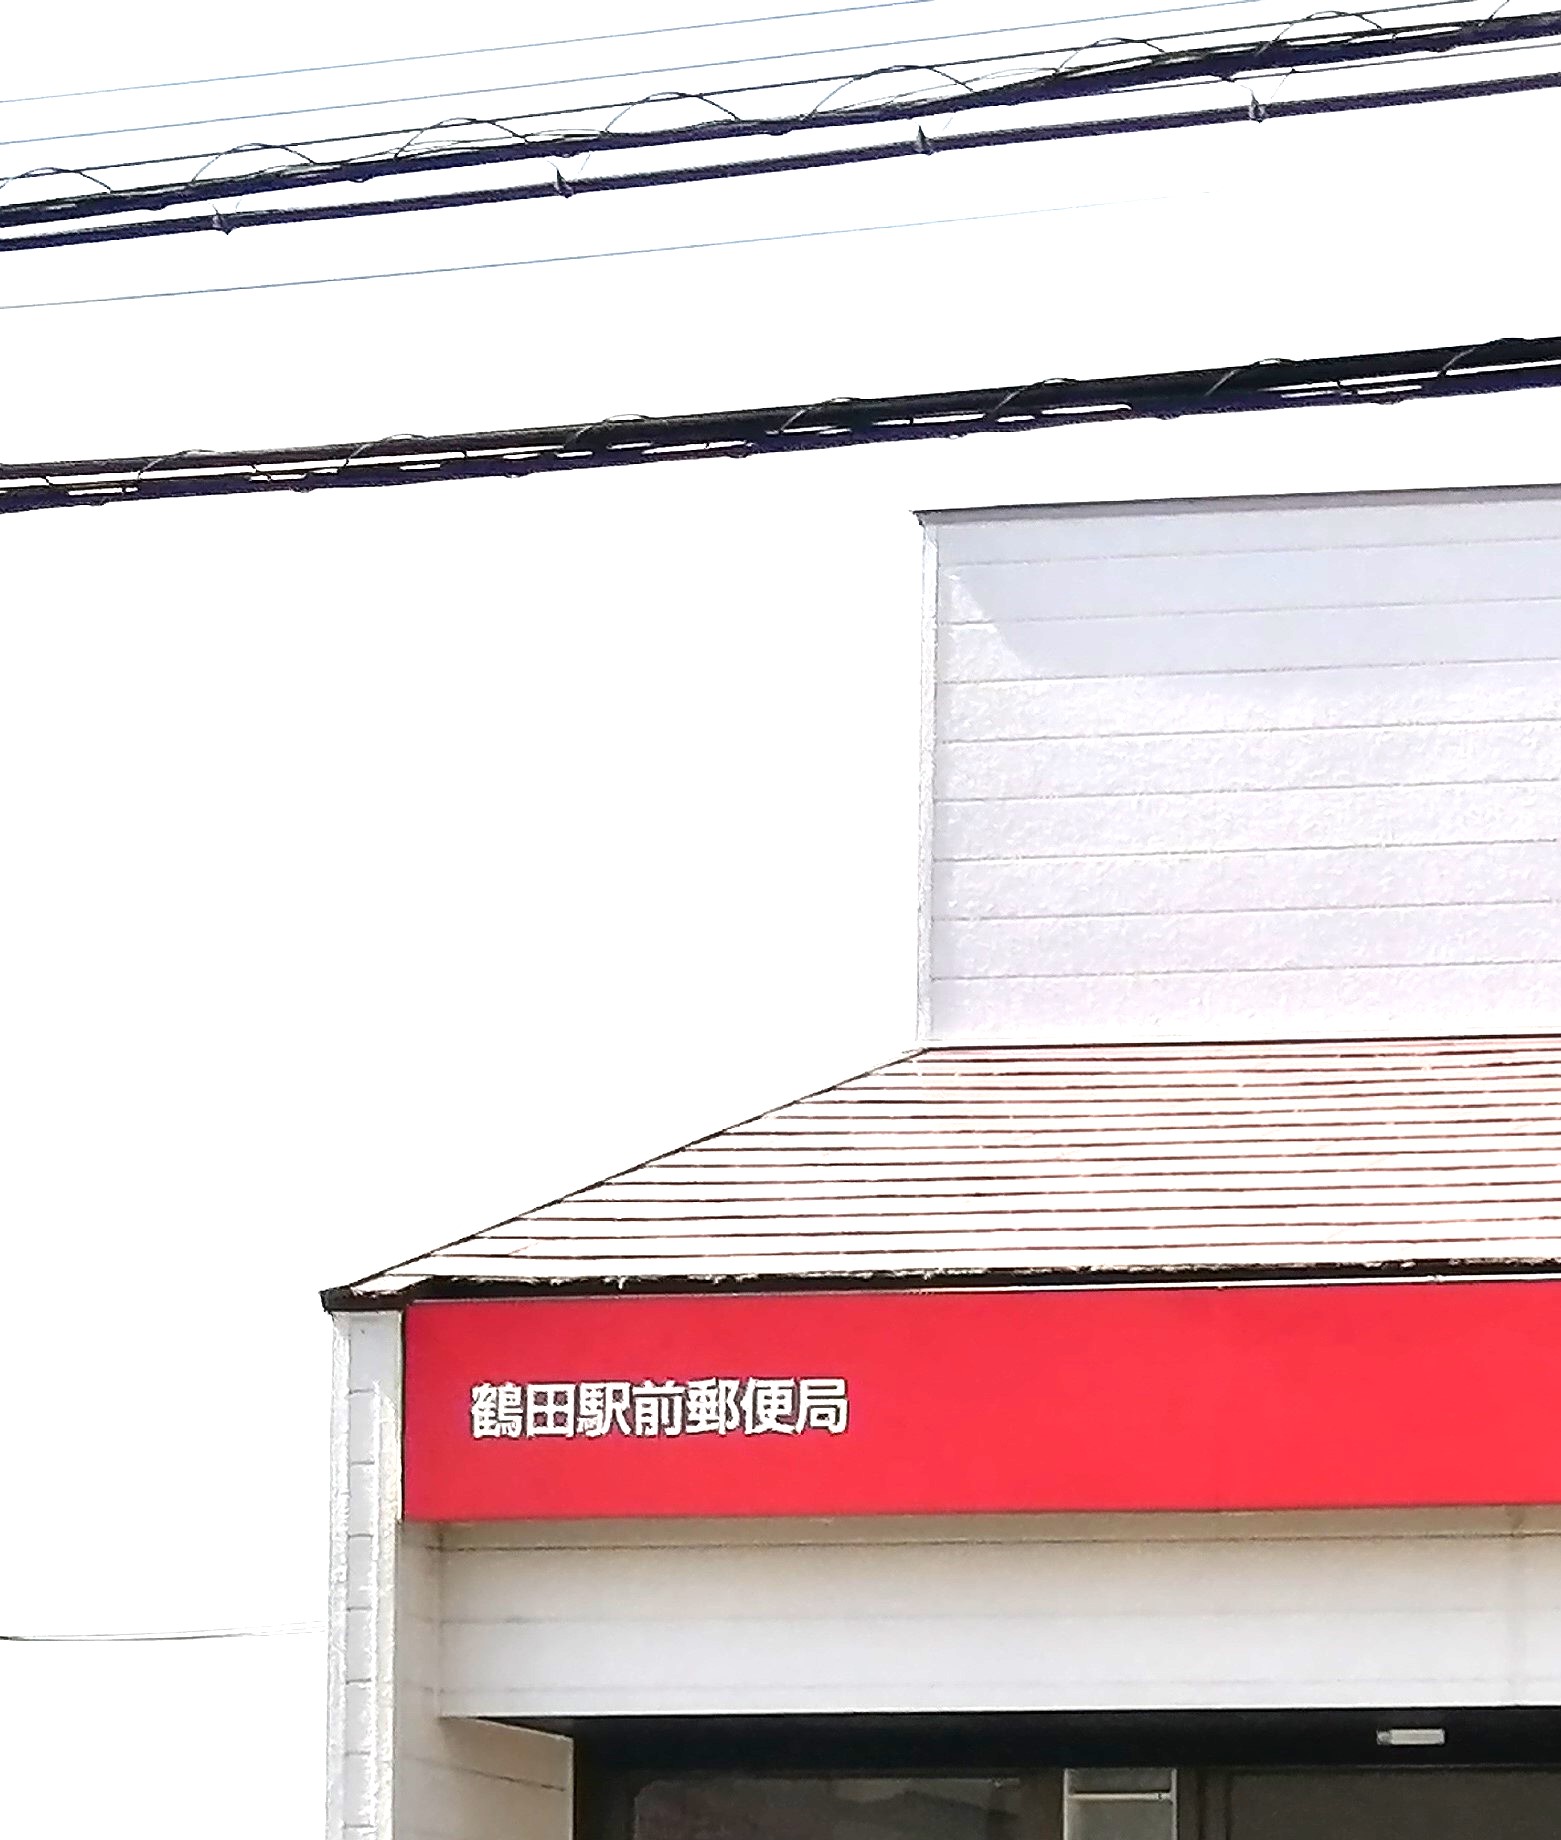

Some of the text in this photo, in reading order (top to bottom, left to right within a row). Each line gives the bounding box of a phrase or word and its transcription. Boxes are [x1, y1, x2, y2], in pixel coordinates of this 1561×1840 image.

[470, 1377, 849, 1439] 鶴田駅前郵便局
